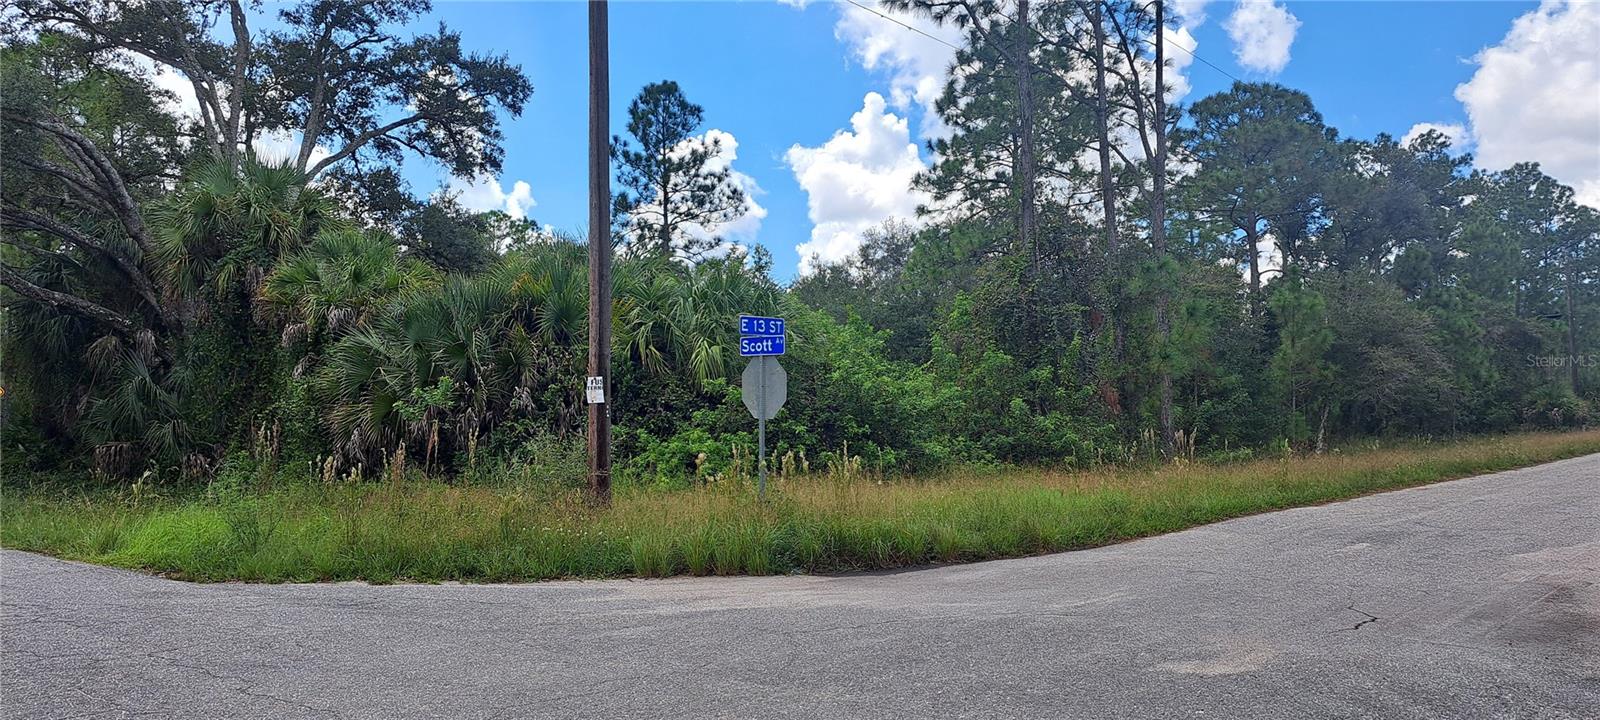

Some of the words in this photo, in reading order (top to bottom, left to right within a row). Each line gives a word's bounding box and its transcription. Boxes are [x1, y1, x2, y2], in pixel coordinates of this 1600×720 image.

[742, 319, 748, 331] E
[753, 320, 765, 332] 13
[769, 321, 782, 333] ST
[742, 339, 772, 352] Scott
